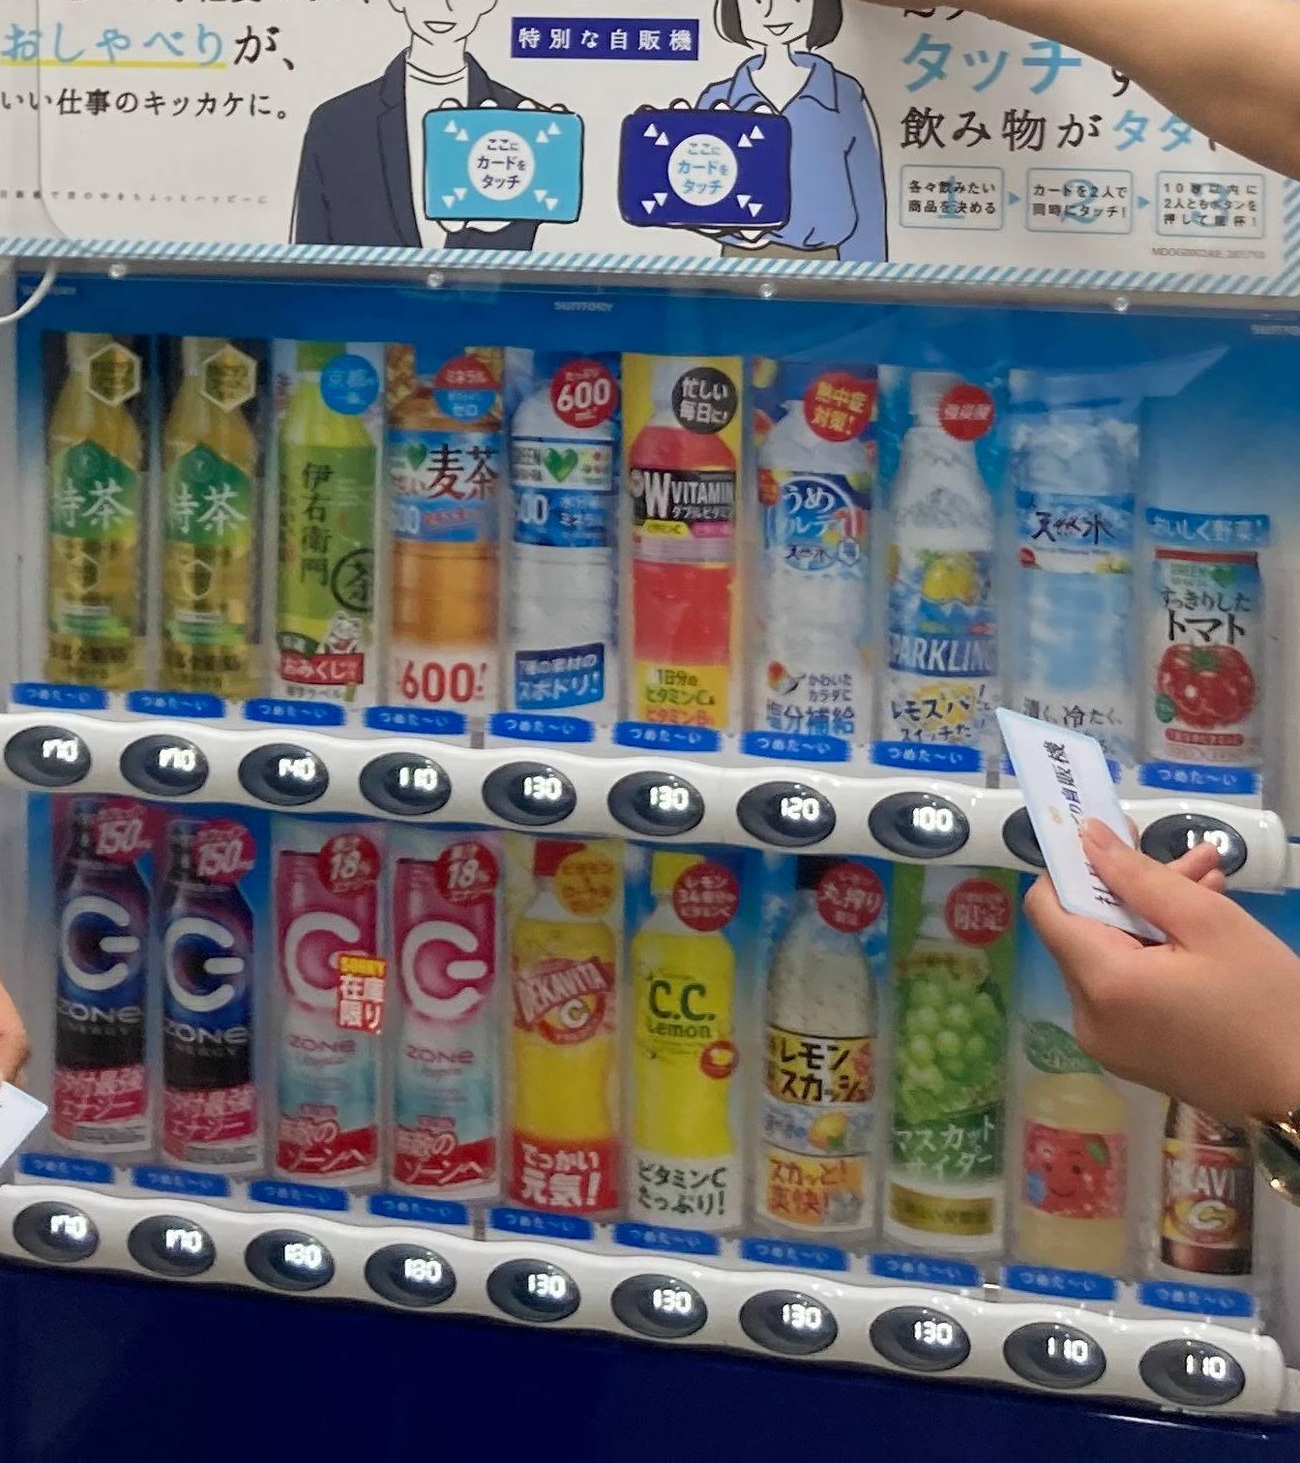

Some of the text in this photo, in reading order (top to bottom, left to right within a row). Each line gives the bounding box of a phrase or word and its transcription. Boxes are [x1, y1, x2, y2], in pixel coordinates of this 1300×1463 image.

[1, 22, 296, 70] おしゃべりが、
[518, 27, 694, 51] 特別な自販機
[1, 88, 287, 120] いい仕事のキッカケに。
[486, 138, 519, 152] ここに
[687, 142, 721, 156] ここに
[477, 155, 526, 172] カードを
[677, 160, 728, 177] カードを
[481, 175, 520, 190] タッチ
[682, 179, 723, 195] タッチ
[908, 179, 996, 195] 各々飲みたい
[1033, 184, 1128, 199] カードを2人で
[908, 199, 996, 215] 商品を決める
[1032, 203, 1127, 219] 同時にタッチ!
[444, 368, 490, 386] ミネラル
[682, 376, 730, 400] 忙しい
[556, 380, 612, 412] 600
[814, 388, 869, 413] 熱中症
[680, 401, 731, 425] 毎日に!
[426, 441, 500, 502] 麦茶
[644, 470, 736, 520] W VITAMIN
[781, 486, 835, 516] うめ
[301, 462, 334, 586] 伊右衛門
[1031, 510, 1115, 544] 天然水
[1160, 583, 1253, 613] すっきりした
[1167, 610, 1247, 643] トマト
[807, 672, 853, 687] かわいた
[807, 688, 853, 702] カラダに
[765, 703, 856, 736] 塩分補給
[523, 775, 563, 801] 130
[649, 785, 689, 811] 130
[780, 795, 820, 822] 120
[912, 806, 953, 832] 100
[340, 976, 384, 1002] 在庫
[516, 960, 607, 1024] DEKAVITA
[649, 979, 716, 1022] C.C.
[339, 1000, 382, 1030] 限り
[646, 1016, 712, 1039] Lemon
[780, 1041, 852, 1072] レモン
[893, 1114, 996, 1152] マスカット
[521, 1142, 600, 1170] でっかい
[637, 1159, 728, 1189] ビタミンC
[769, 1158, 849, 1187] スカッと!
[521, 1168, 602, 1208] 元気!
[637, 1187, 726, 1217] たっぷり!
[527, 1273, 567, 1299] 130
[652, 1288, 693, 1314] 130
[781, 1303, 822, 1329] 130
[913, 1320, 954, 1346] 130
[1047, 1336, 1089, 1363] 110
[1186, 1354, 1228, 1379] 110
